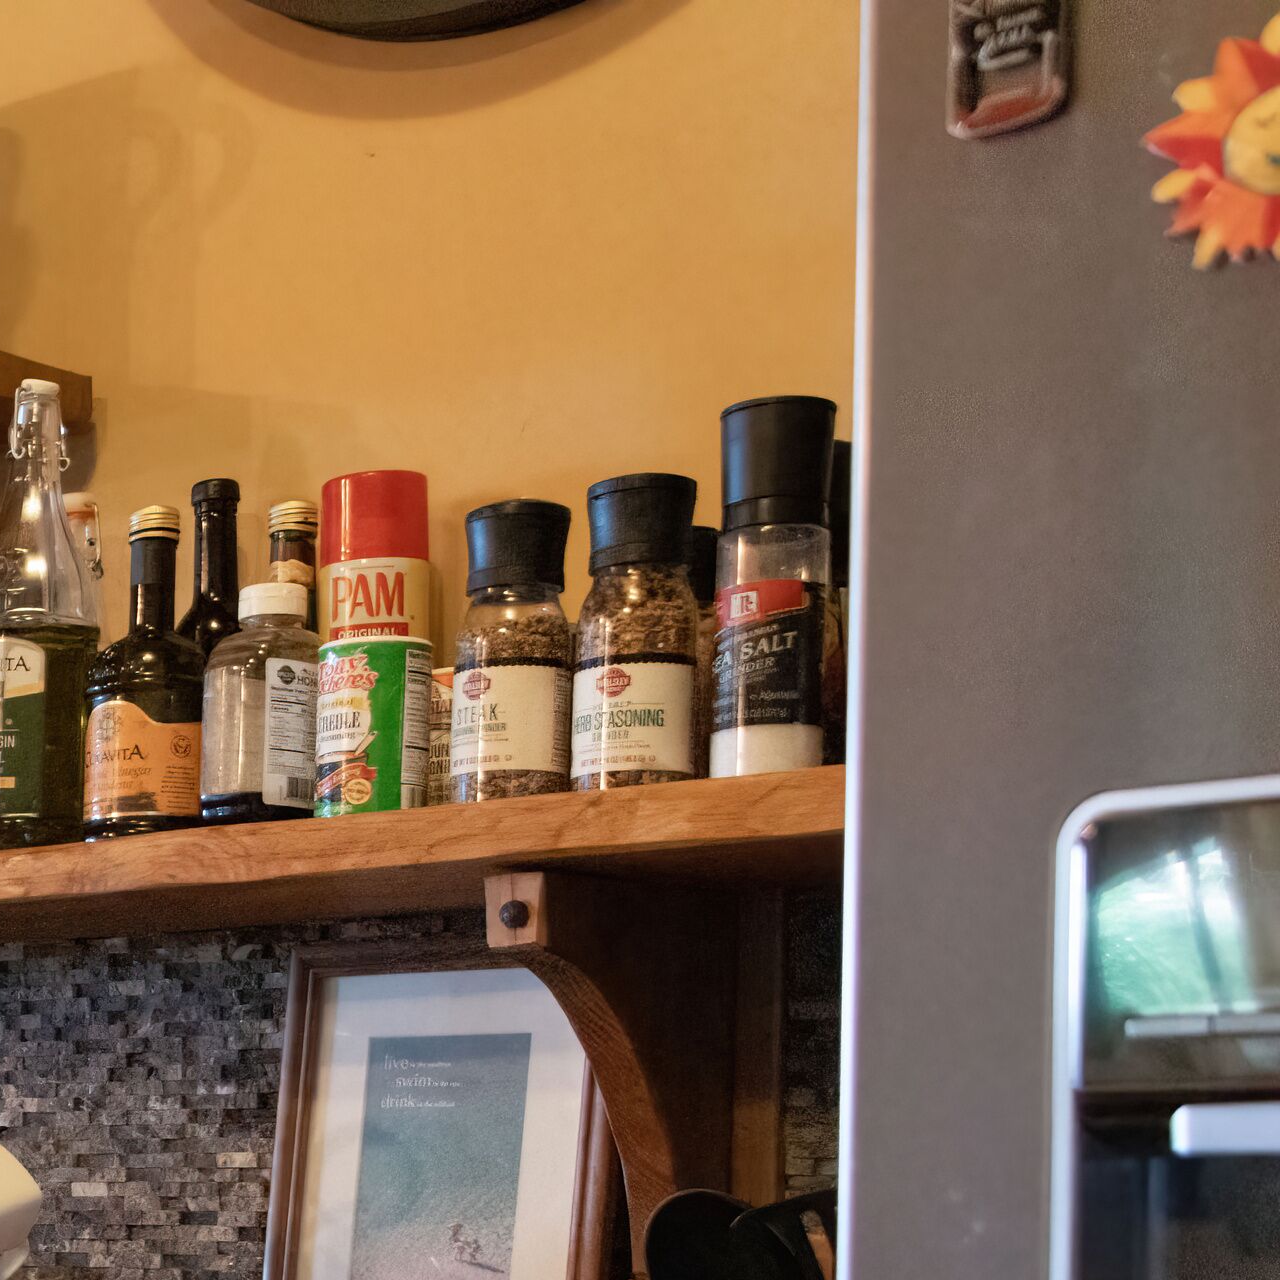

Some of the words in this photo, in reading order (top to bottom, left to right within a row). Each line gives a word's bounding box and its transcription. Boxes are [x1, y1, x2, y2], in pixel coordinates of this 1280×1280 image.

[332, 571, 404, 621] PAM
[741, 631, 798, 661] SALT
[457, 703, 498, 726] STEAK
[384, 1053, 409, 1071] live
[395, 1073, 432, 1088] swim
[381, 1093, 416, 1109] drink
